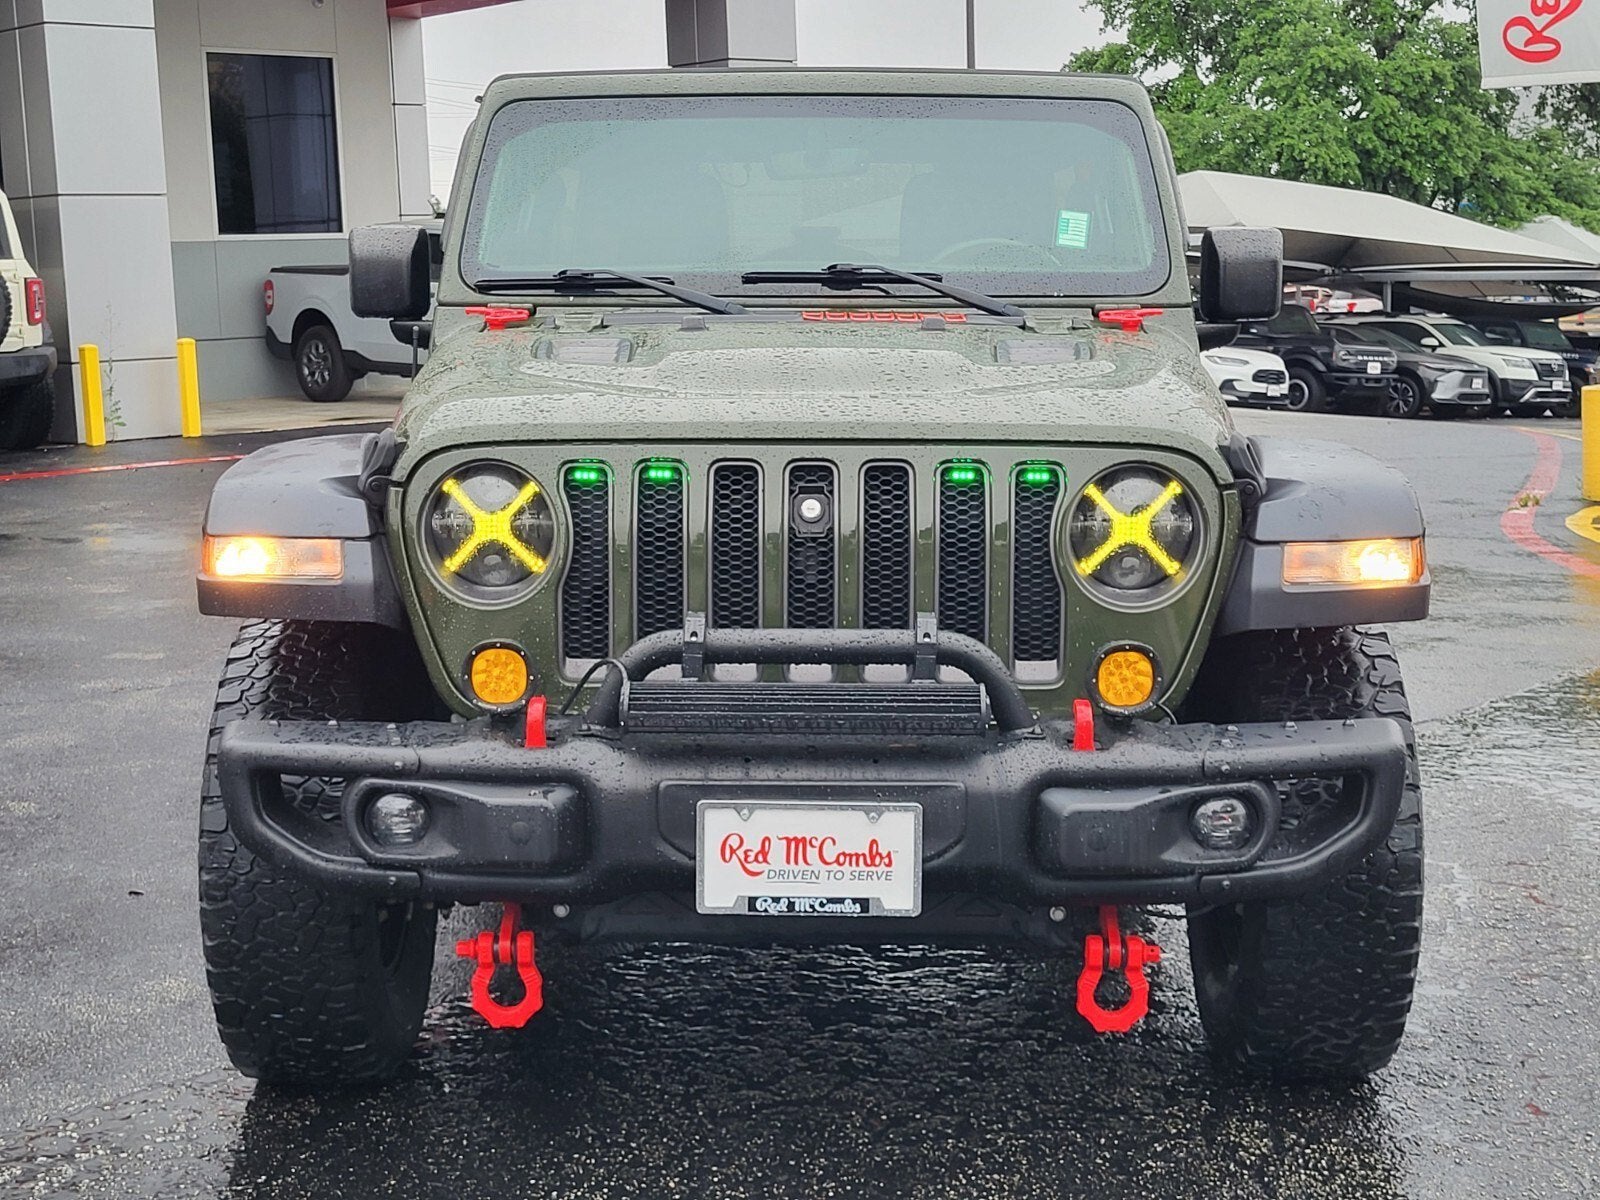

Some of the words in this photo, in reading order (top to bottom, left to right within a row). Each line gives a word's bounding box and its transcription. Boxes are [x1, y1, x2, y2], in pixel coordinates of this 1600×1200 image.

[720, 833, 771, 876] Red
[777, 835, 893, 868] McCombs
[767, 869, 821, 881] DRIVEN
[826, 870, 845, 881] TO
[849, 870, 893, 882] SERVE
[755, 896, 788, 914] Red
[790, 897, 861, 913] McCombs
